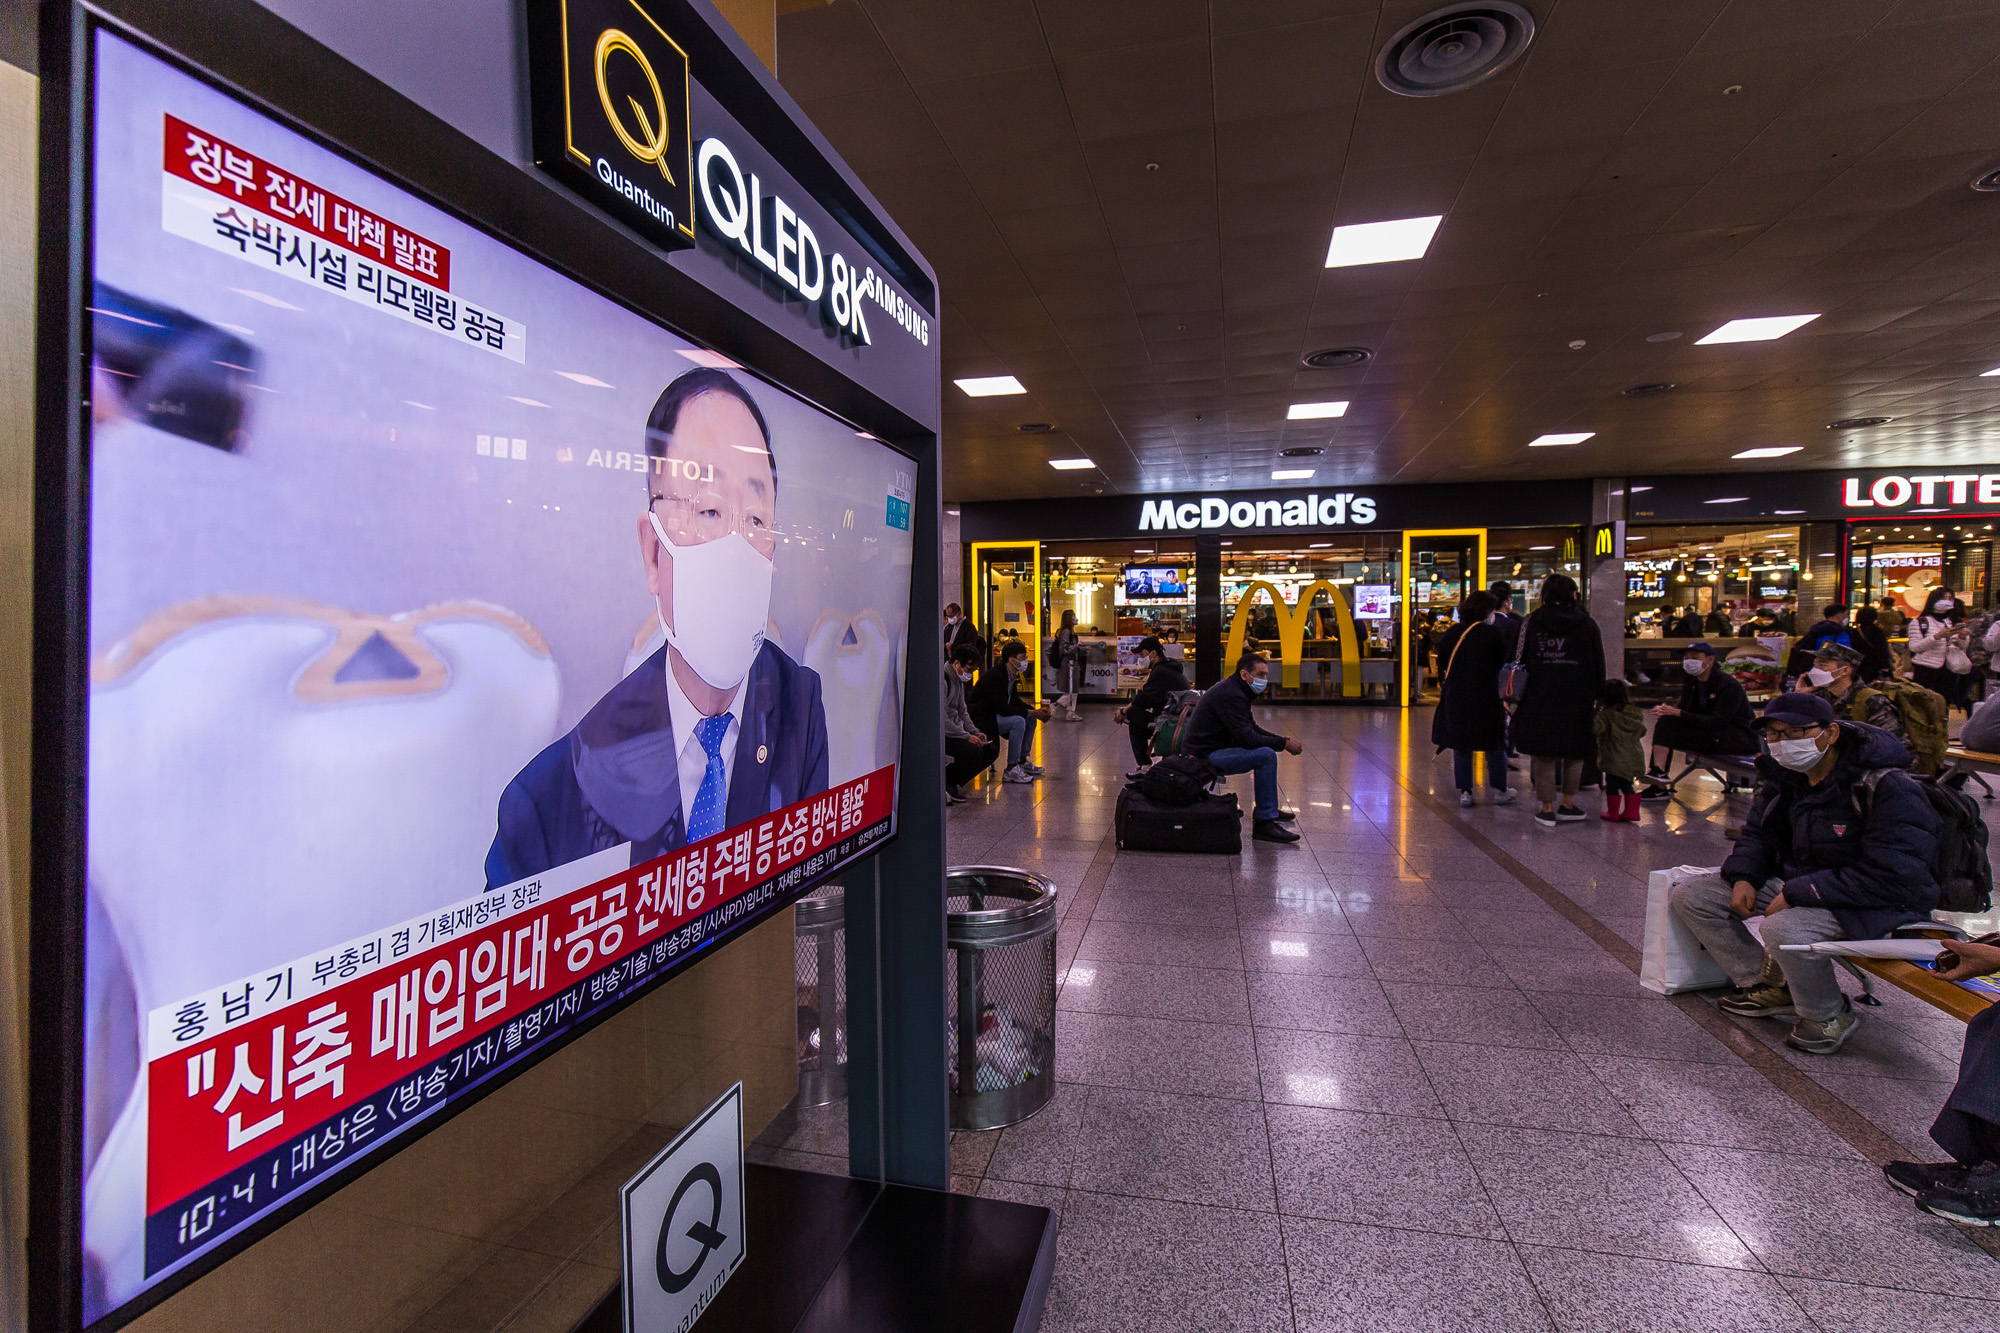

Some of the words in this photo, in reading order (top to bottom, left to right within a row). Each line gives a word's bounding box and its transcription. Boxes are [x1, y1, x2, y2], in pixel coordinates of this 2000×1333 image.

[184, 131, 257, 196] 정부
[264, 169, 325, 233] 전세
[333, 203, 386, 259] 대책
[392, 229, 439, 280] 발표
[596, 158, 675, 229] Quantum
[213, 207, 346, 291] 숙박시설
[357, 262, 456, 331] 리모델링
[463, 306, 505, 350] 공급
[698, 137, 824, 301] QLED
[832, 252, 872, 346] 8K
[866, 266, 929, 347] SAMSUNG
[895, 469, 912, 490] YTN
[1138, 493, 1377, 530] McDonald's
[1844, 474, 2000, 507] LOTTE
[187, 1001, 352, 1152] "신축
[635, 846, 708, 936] 전세형
[712, 828, 752, 895] 주택
[756, 820, 774, 875] 등
[777, 806, 809, 865] 순증
[811, 793, 839, 847] 방식
[840, 778, 869, 833] 활용"
[312, 937, 381, 986] 부총리
[390, 927, 410, 957] 겸
[418, 893, 507, 943] 기획재정부
[511, 880, 542, 910] 장관
[178, 1159, 279, 1244] 10:41
[292, 1104, 378, 1179] 대상은
[777, 868, 802, 892] 자세한
[803, 854, 824, 877] 내용은
[858, 821, 888, 847] 유진투자증권
[673, 1268, 726, 1333] antum
